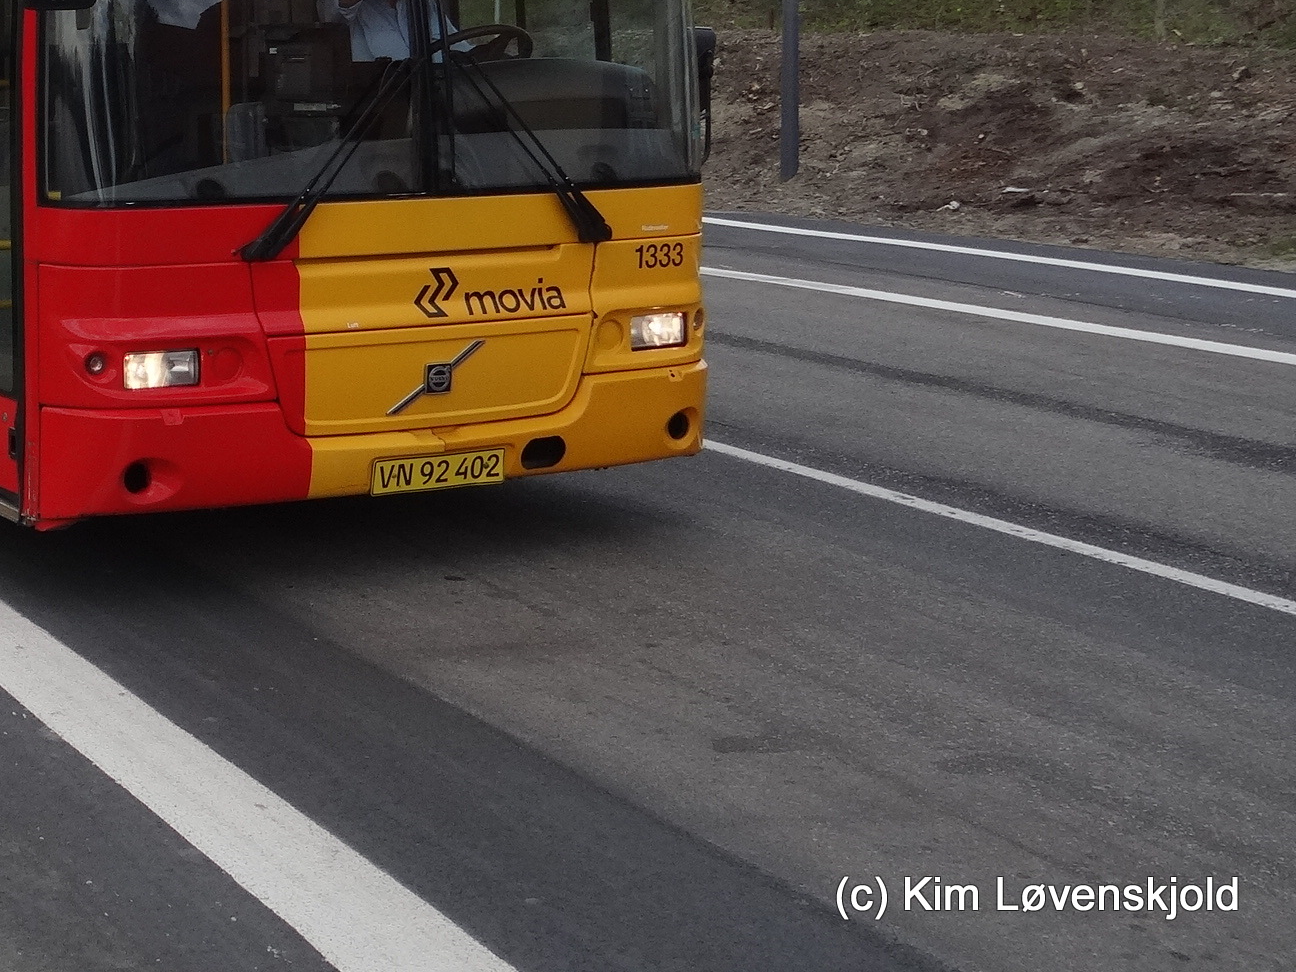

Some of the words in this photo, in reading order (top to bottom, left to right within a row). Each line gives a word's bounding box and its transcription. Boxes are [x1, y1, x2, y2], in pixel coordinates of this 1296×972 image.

[635, 242, 684, 269] 1333
[464, 277, 566, 316] movia
[379, 462, 414, 489] VN
[420, 459, 450, 485] 92
[454, 453, 500, 480] 402
